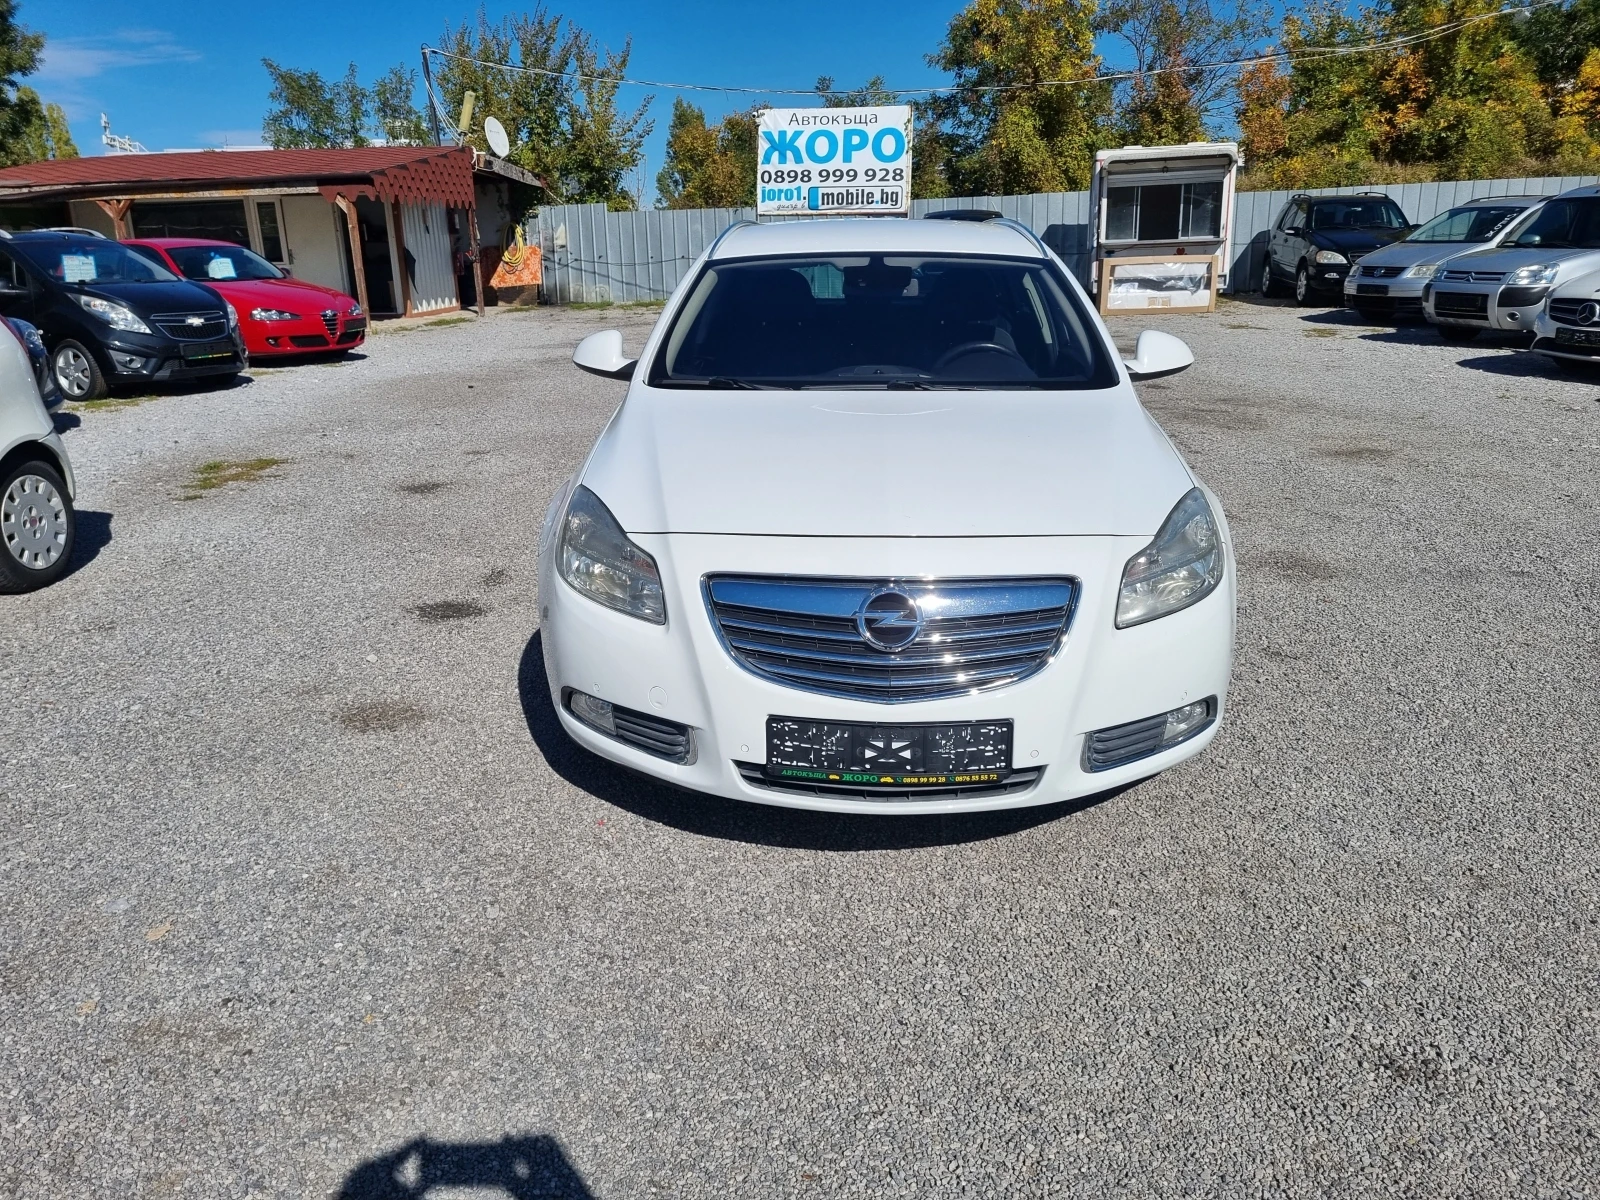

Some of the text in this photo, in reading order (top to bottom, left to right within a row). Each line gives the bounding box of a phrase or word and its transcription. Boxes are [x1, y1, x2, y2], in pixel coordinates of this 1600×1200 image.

[788, 112, 878, 127] Автокъща
[761, 127, 905, 164] ЖОРО
[760, 168, 904, 183] 0898 999 928
[821, 188, 899, 206] mobile.bg
[782, 770, 877, 782] АВТОКЪЩА ЖОРО
